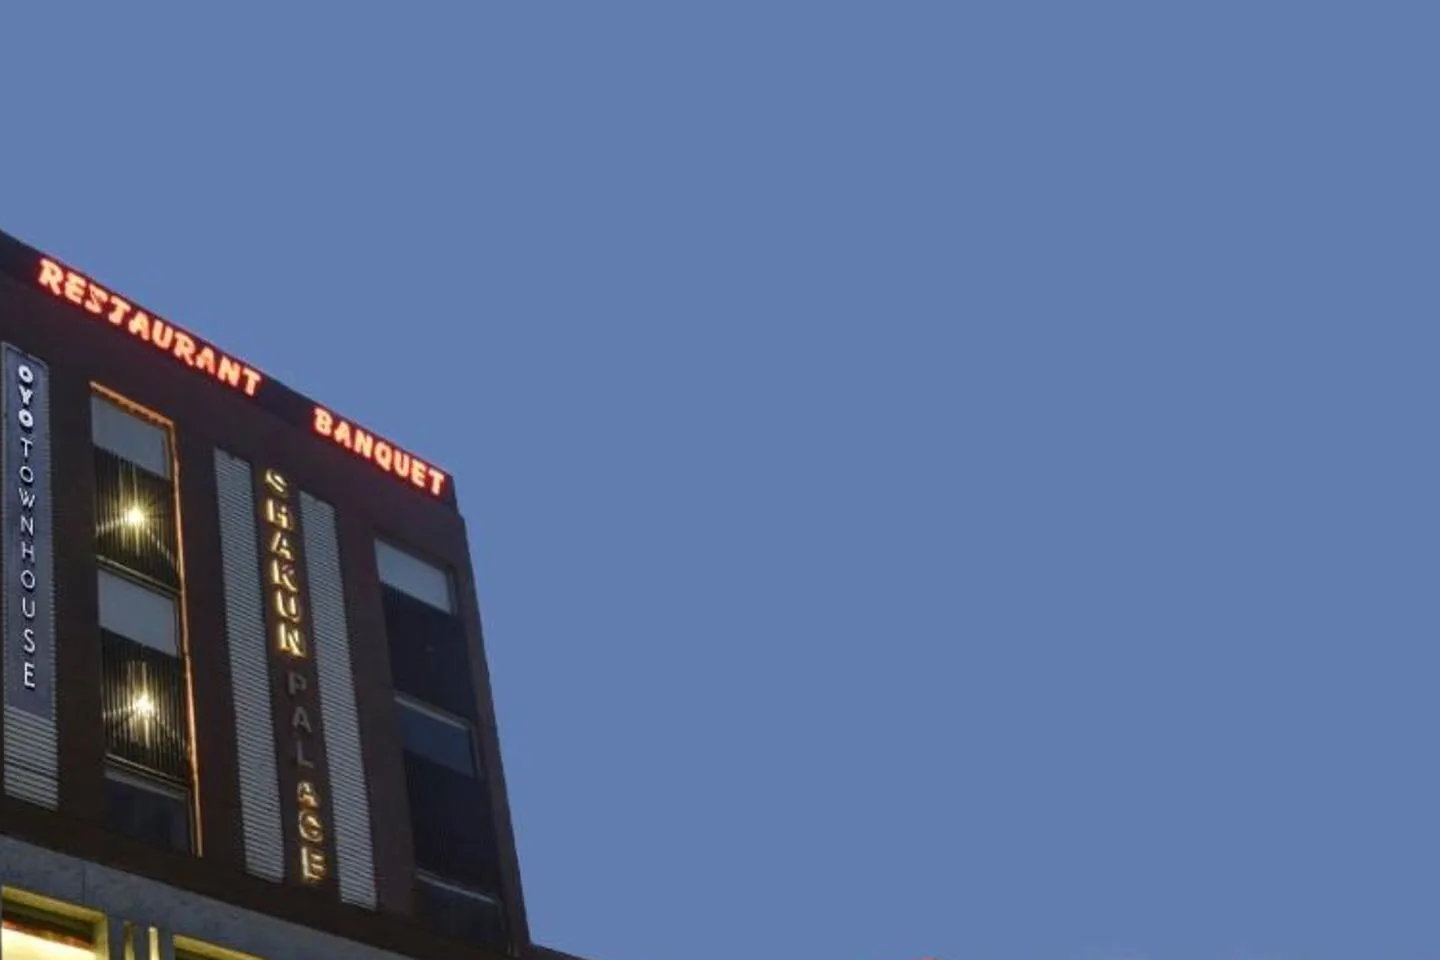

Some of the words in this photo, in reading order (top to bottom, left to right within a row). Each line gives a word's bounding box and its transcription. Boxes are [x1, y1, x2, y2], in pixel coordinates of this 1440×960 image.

[18, 364, 34, 428] OYO
[36, 256, 263, 398] RESTAURANT
[312, 405, 447, 497] BANQUET
[18, 436, 36, 689] TOWNHOUSE
[264, 466, 307, 660] SHAKUN
